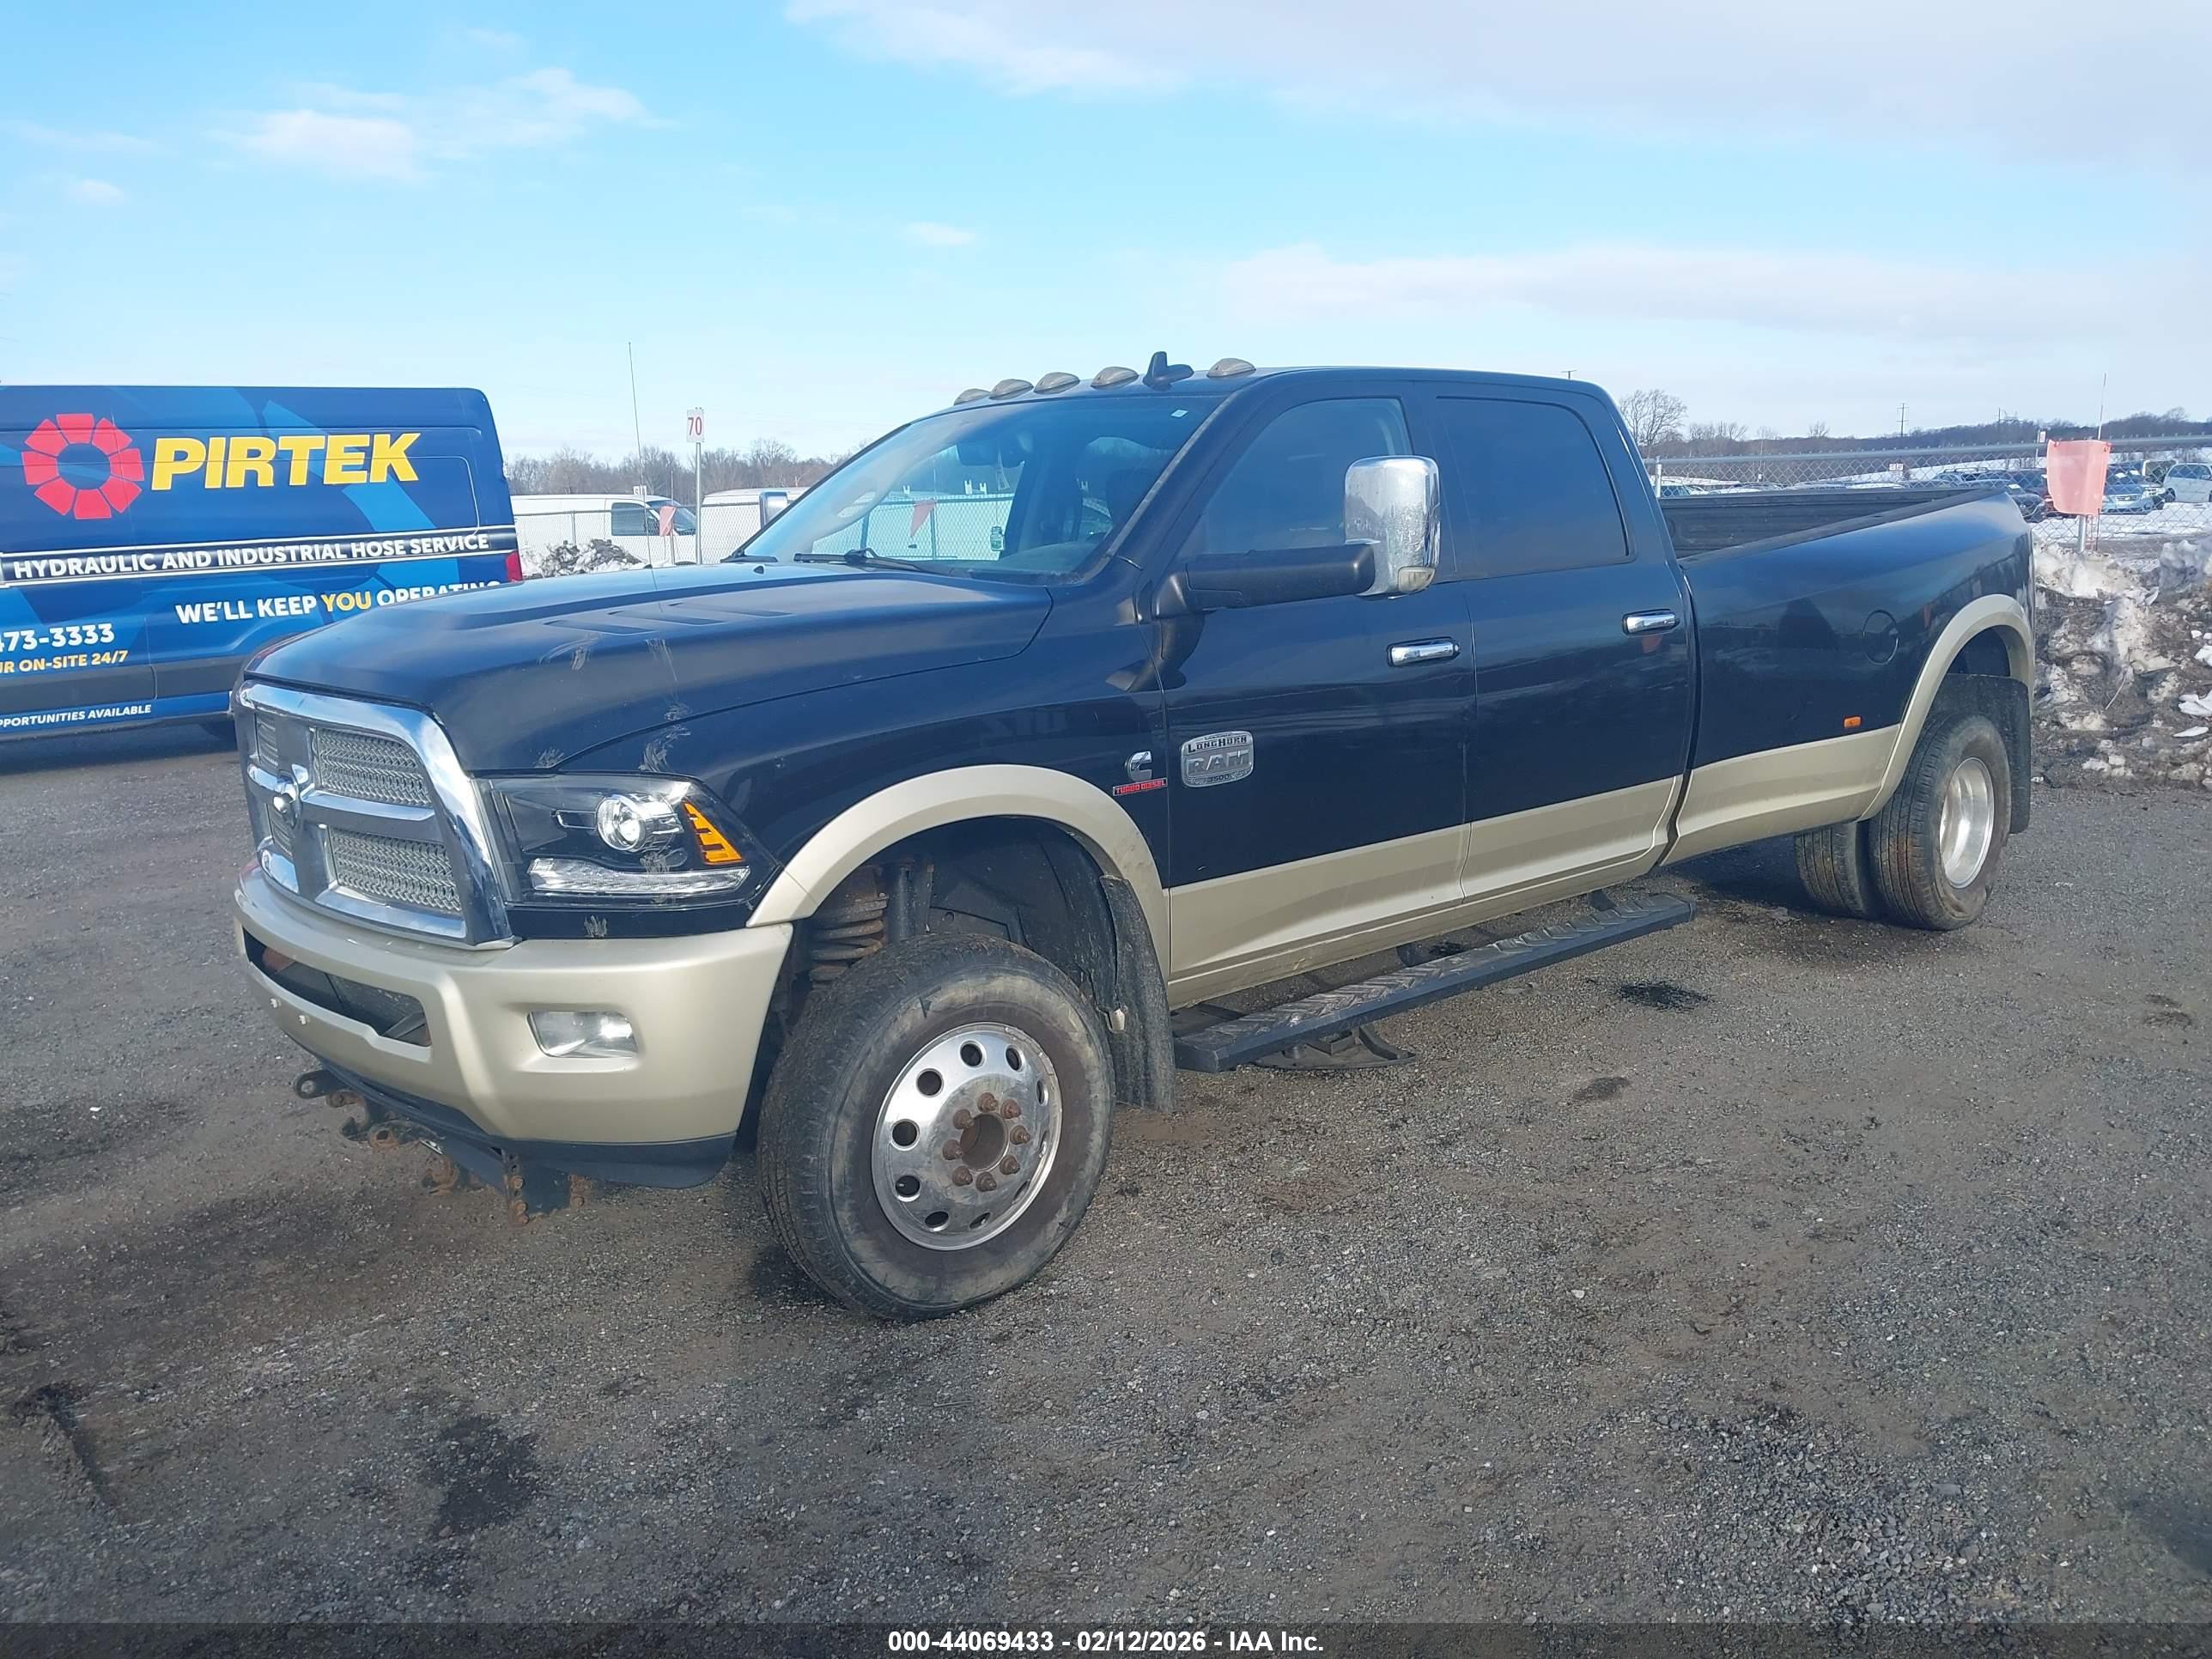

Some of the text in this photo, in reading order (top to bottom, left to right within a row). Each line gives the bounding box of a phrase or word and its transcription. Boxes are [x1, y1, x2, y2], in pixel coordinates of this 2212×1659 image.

[687, 416, 702, 436] 70
[151, 433, 421, 491] PIRTEK
[14, 533, 489, 579] HYDRAULIC AND INDUSTRIAL HOSE SERVICE
[174, 580, 501, 624] WE’LL KEEP YOU OPERA
[0, 650, 129, 674] R ON-SITE 24/7
[88, 704, 152, 720] AVAILABLE
[1186, 749, 1250, 775] RAM
